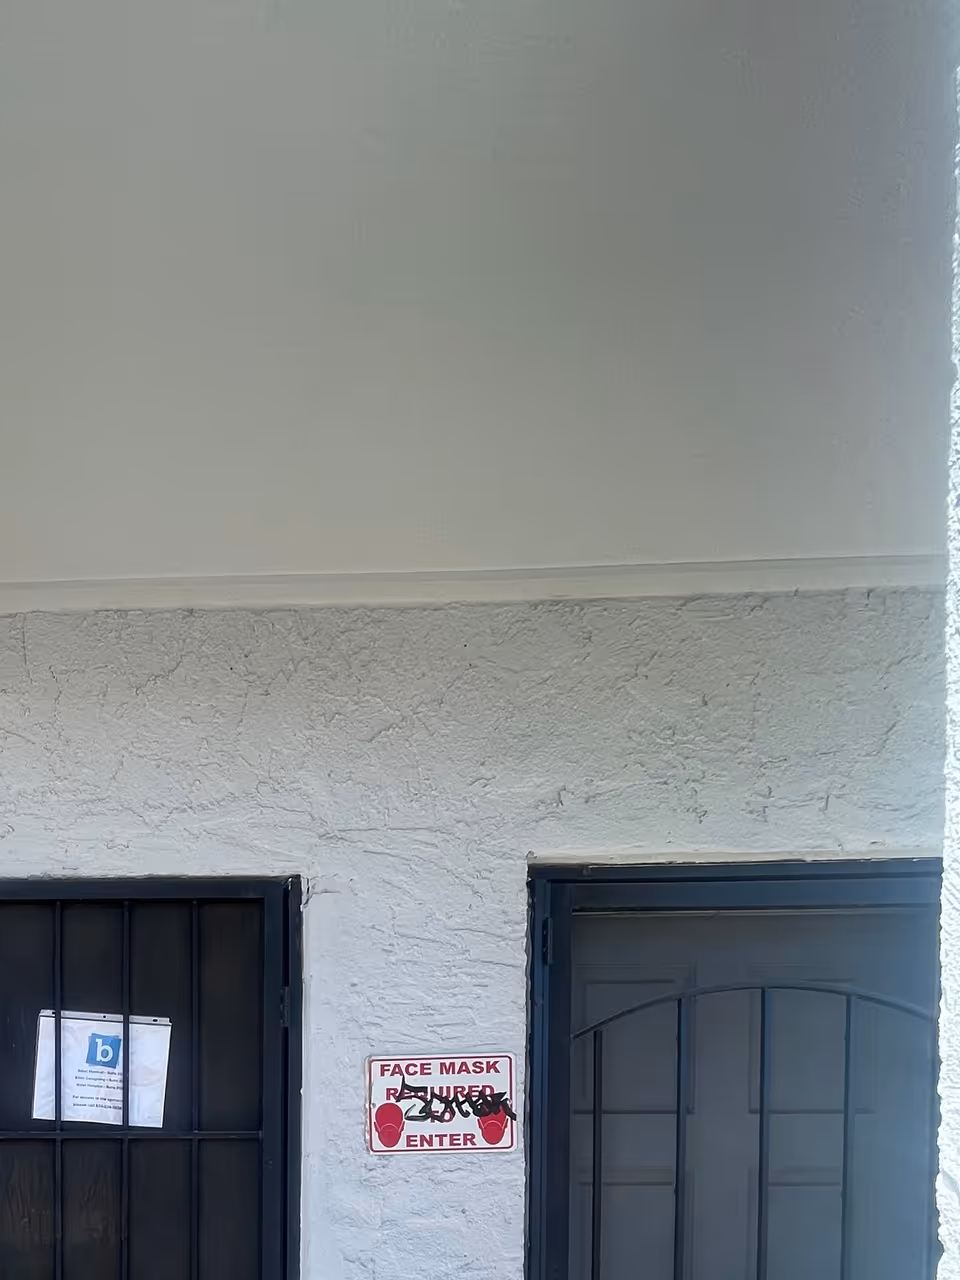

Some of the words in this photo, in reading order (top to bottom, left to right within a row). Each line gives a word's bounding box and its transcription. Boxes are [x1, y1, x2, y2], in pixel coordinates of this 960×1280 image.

[95, 1038, 114, 1062] b
[380, 1063, 432, 1076] FACE
[439, 1061, 501, 1075] MASK
[406, 1133, 477, 1148] ENTER
